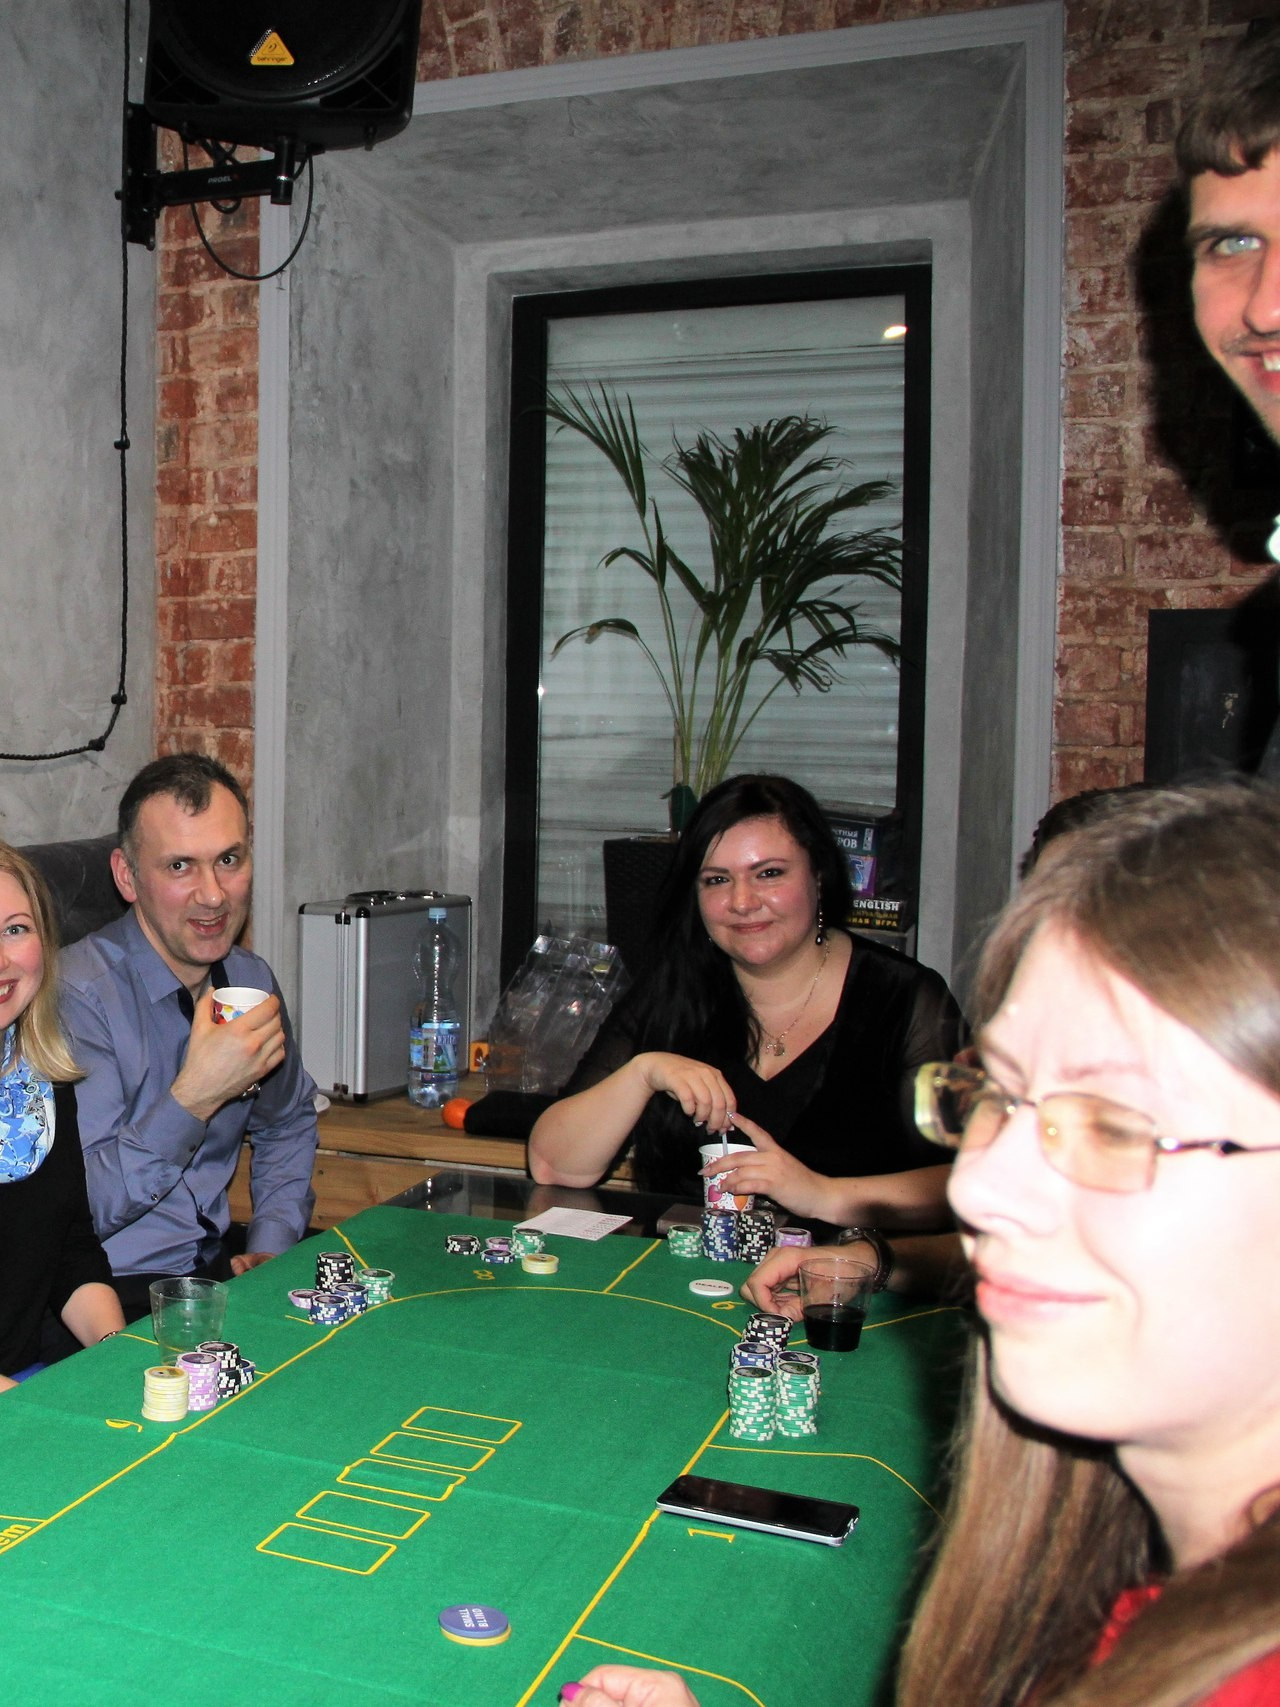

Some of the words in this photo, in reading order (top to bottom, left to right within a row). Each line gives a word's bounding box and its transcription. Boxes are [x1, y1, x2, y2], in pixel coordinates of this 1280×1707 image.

[207, 175, 233, 184] PROEL
[853, 899, 899, 911] ENGLISH
[695, 1282, 730, 1290] DEALER
[458, 1608, 475, 1628] SMALL
[471, 1608, 489, 1628] BLIND
